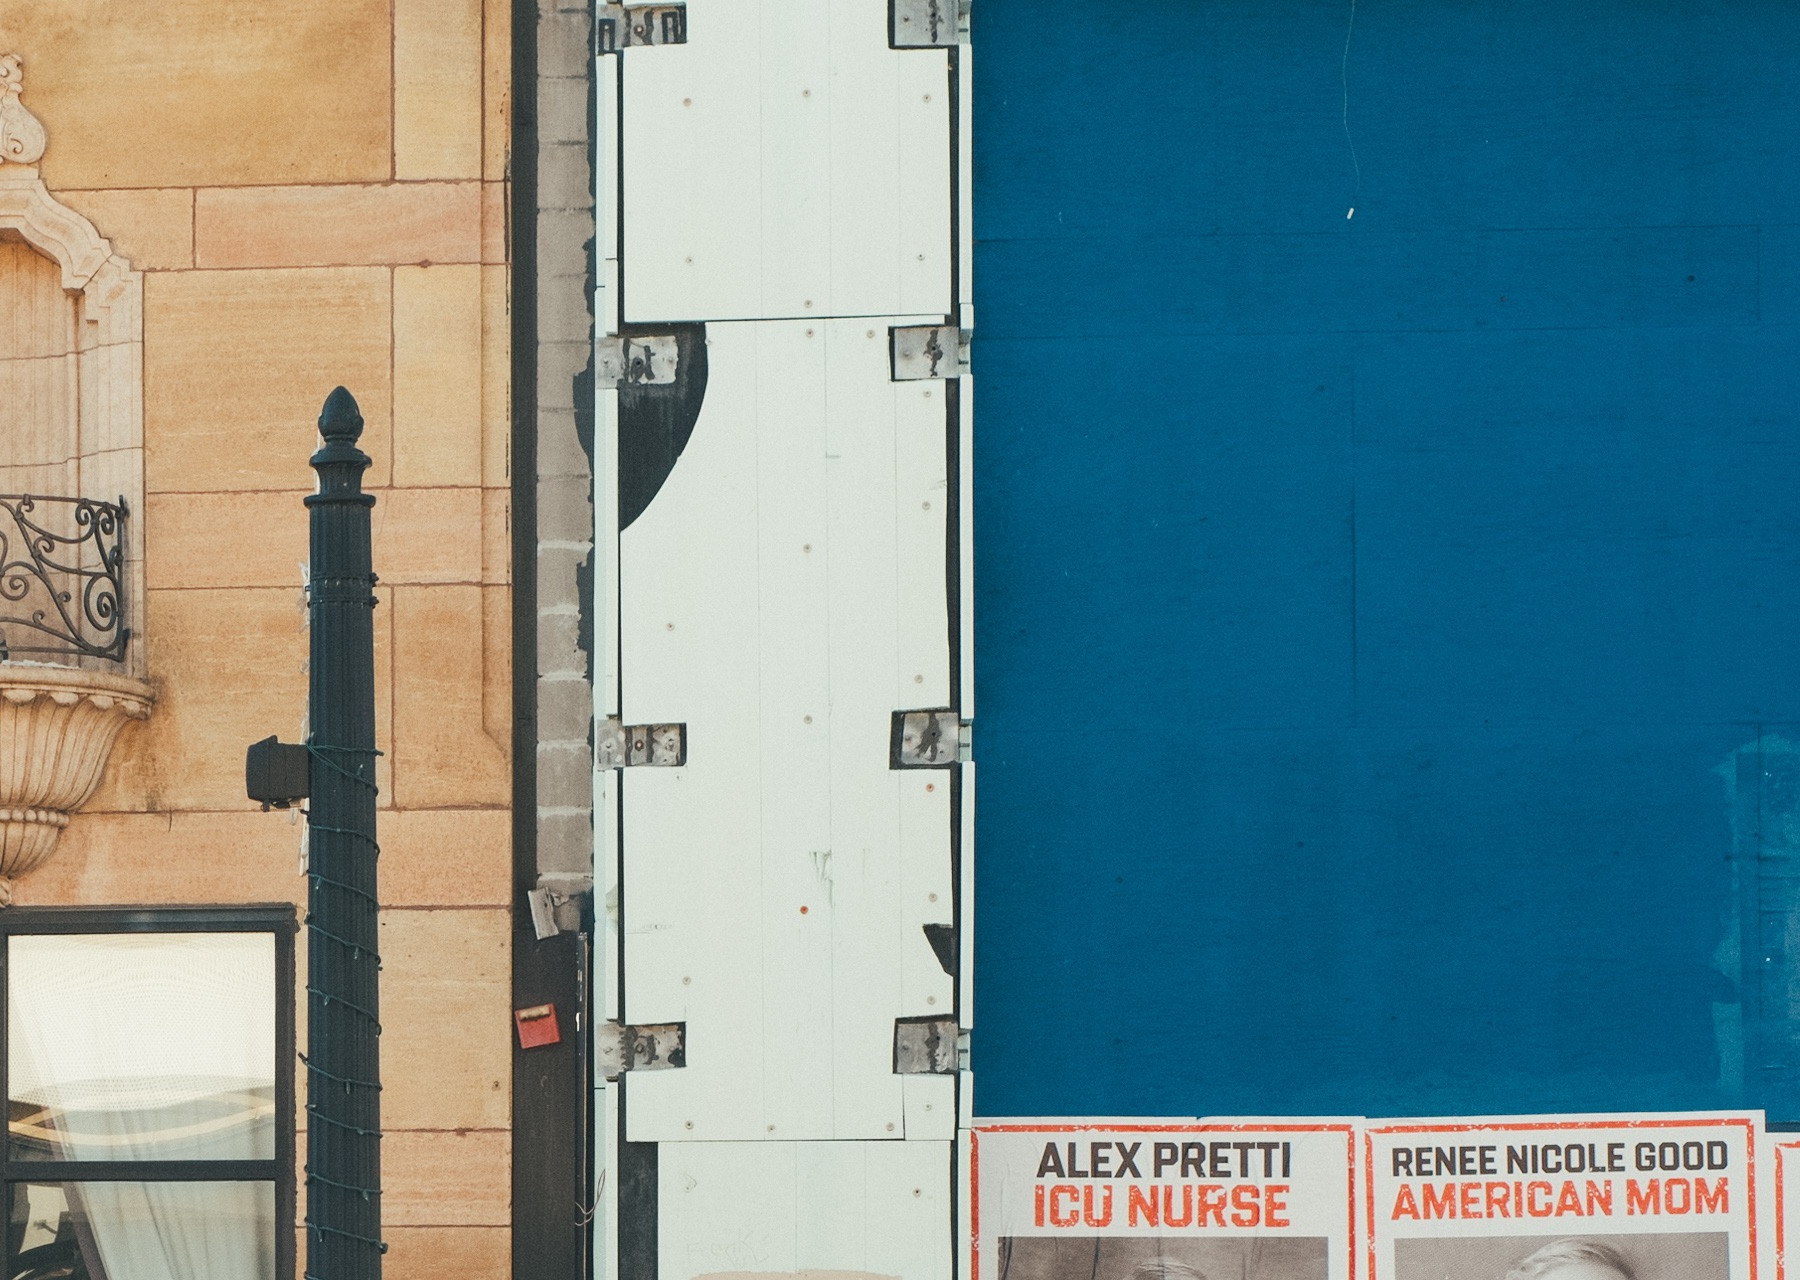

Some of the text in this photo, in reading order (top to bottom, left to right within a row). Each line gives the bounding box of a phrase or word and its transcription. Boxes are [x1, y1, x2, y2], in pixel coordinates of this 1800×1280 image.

[1036, 1141, 1291, 1179] ALEX PRETTI
[1391, 1140, 1729, 1177] RENEE NICOLE GOOD
[1034, 1184, 1290, 1228] ICU NURSE
[1391, 1176, 1729, 1221] AMERICAN MOM
